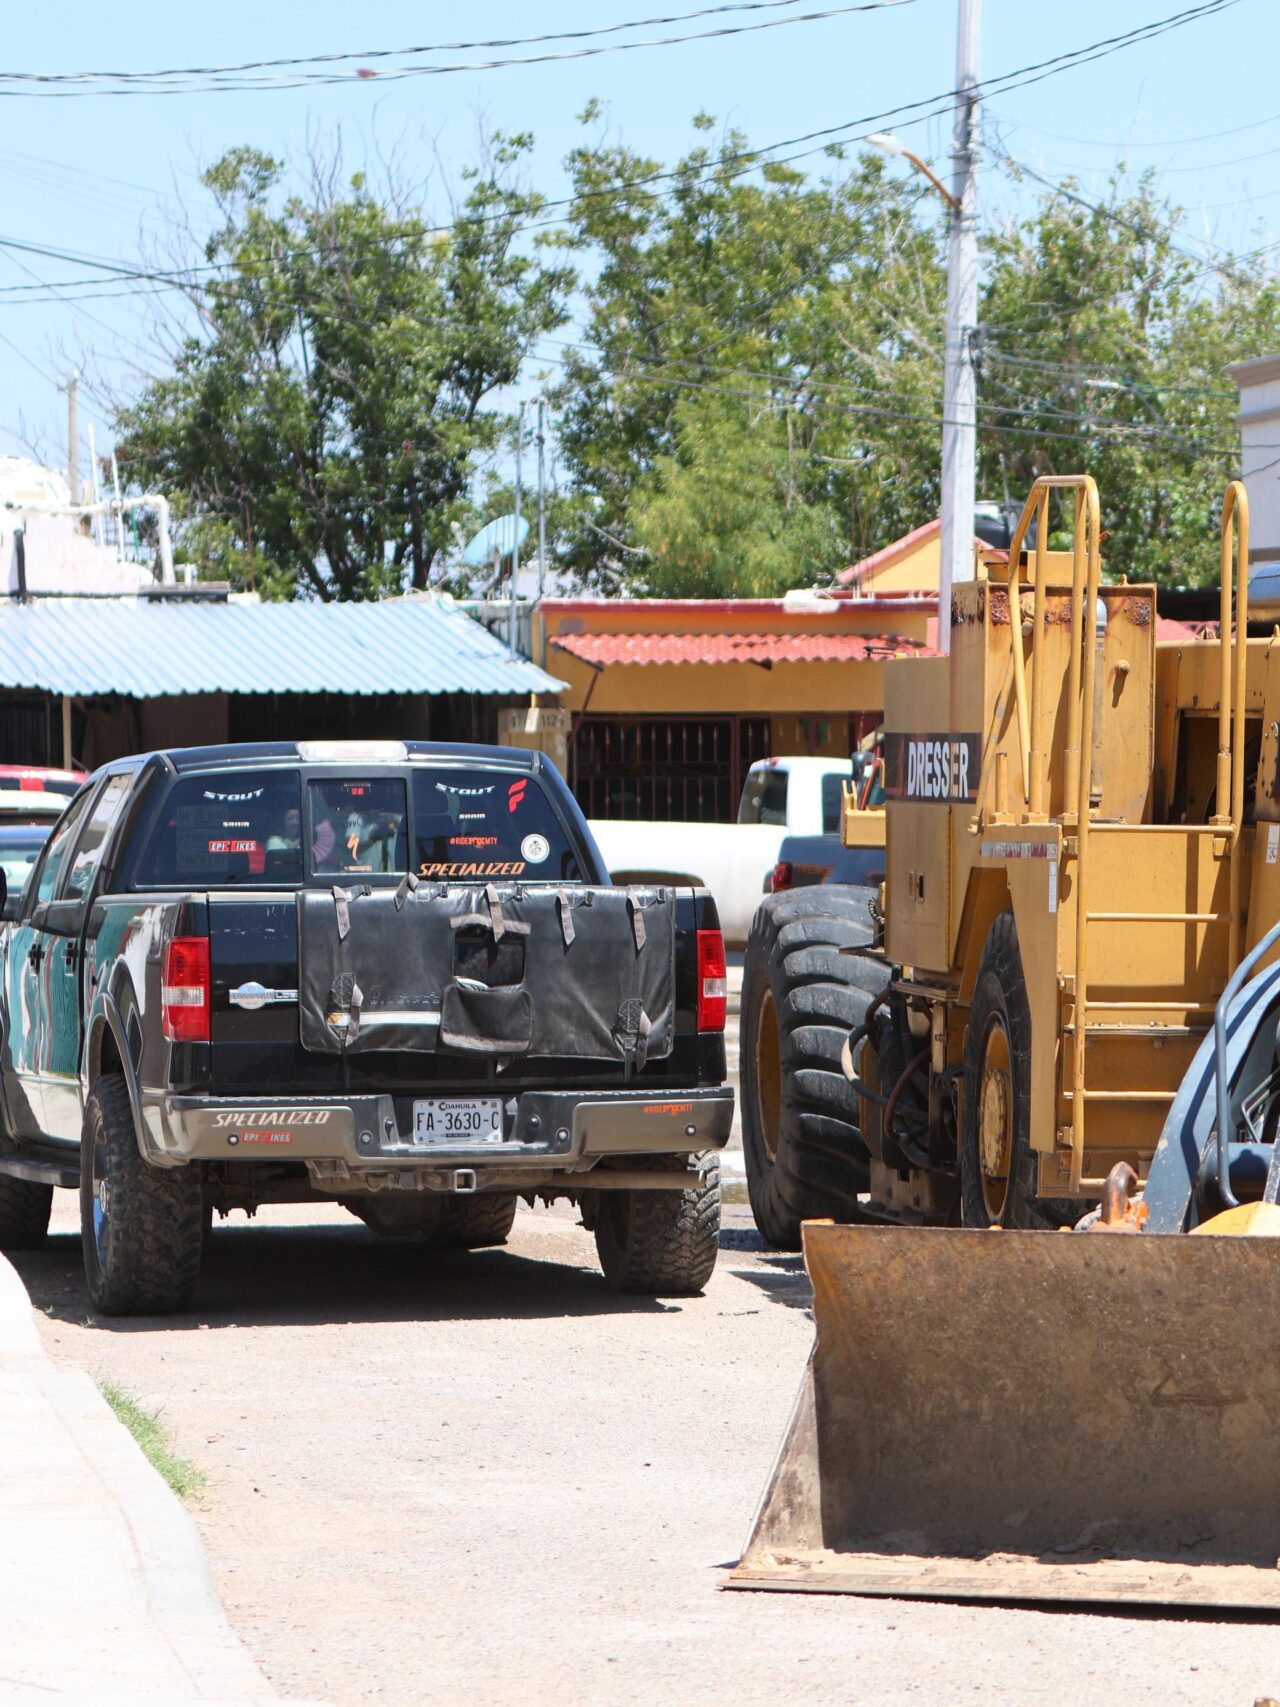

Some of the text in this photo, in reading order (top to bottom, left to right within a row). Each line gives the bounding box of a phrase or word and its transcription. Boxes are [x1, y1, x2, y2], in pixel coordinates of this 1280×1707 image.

[907, 741, 969, 798] DRESSER
[203, 788, 265, 801] STOUT
[435, 782, 496, 795] STOUT
[416, 862, 526, 877] SPECIALIZED
[211, 1110, 331, 1128] SPECIALIZED
[417, 1112, 500, 1131] FA-3630-C
